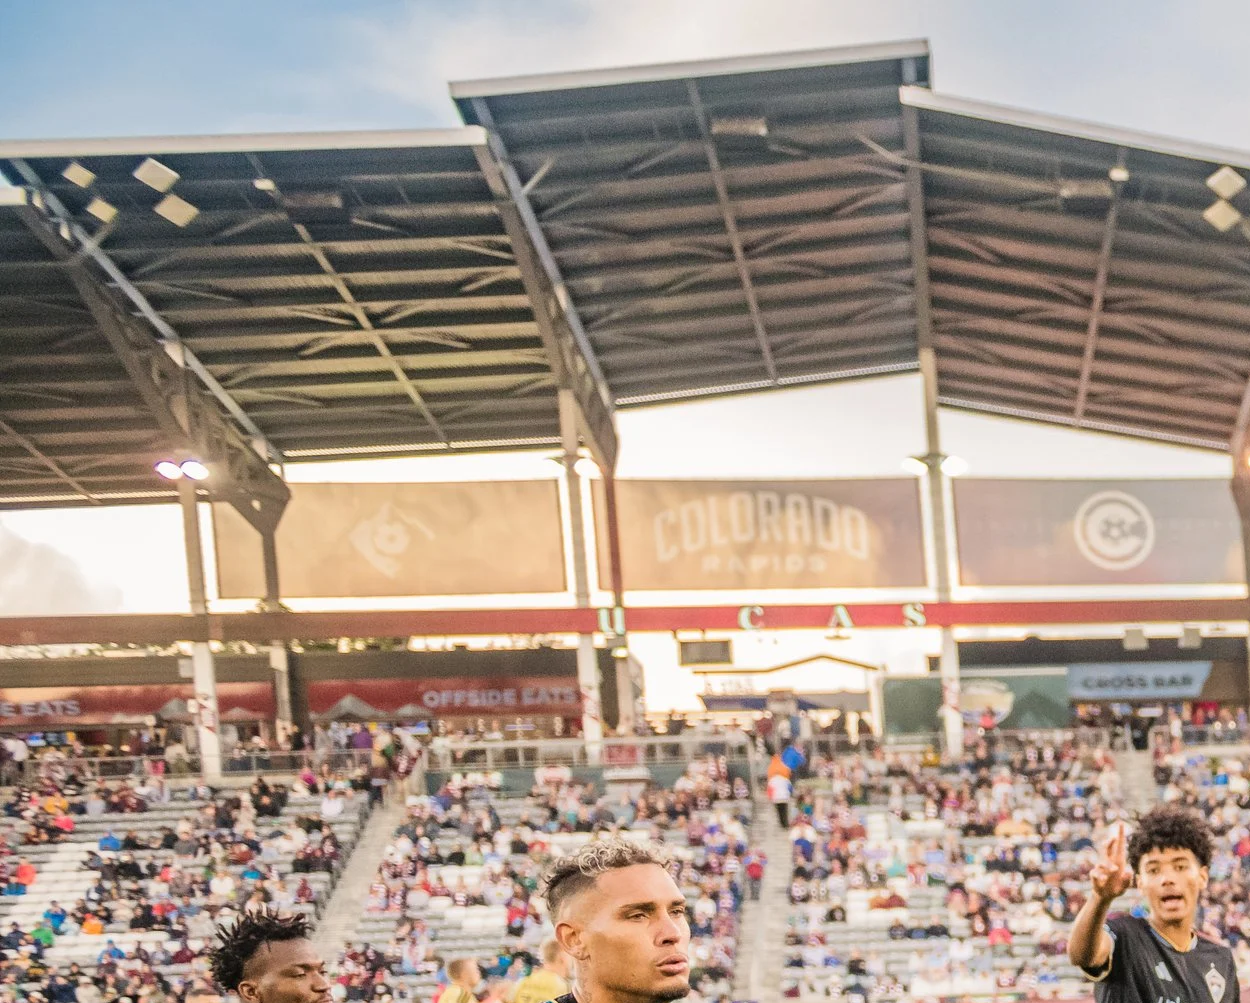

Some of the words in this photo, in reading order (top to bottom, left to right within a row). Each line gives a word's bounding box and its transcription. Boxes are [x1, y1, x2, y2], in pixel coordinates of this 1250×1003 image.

[654, 490, 869, 563] COLORADO
[702, 553, 828, 574] RAPIDS
[21, 700, 82, 717] EATS
[422, 689, 517, 709] OFFSIDE
[521, 687, 577, 706] EATS
